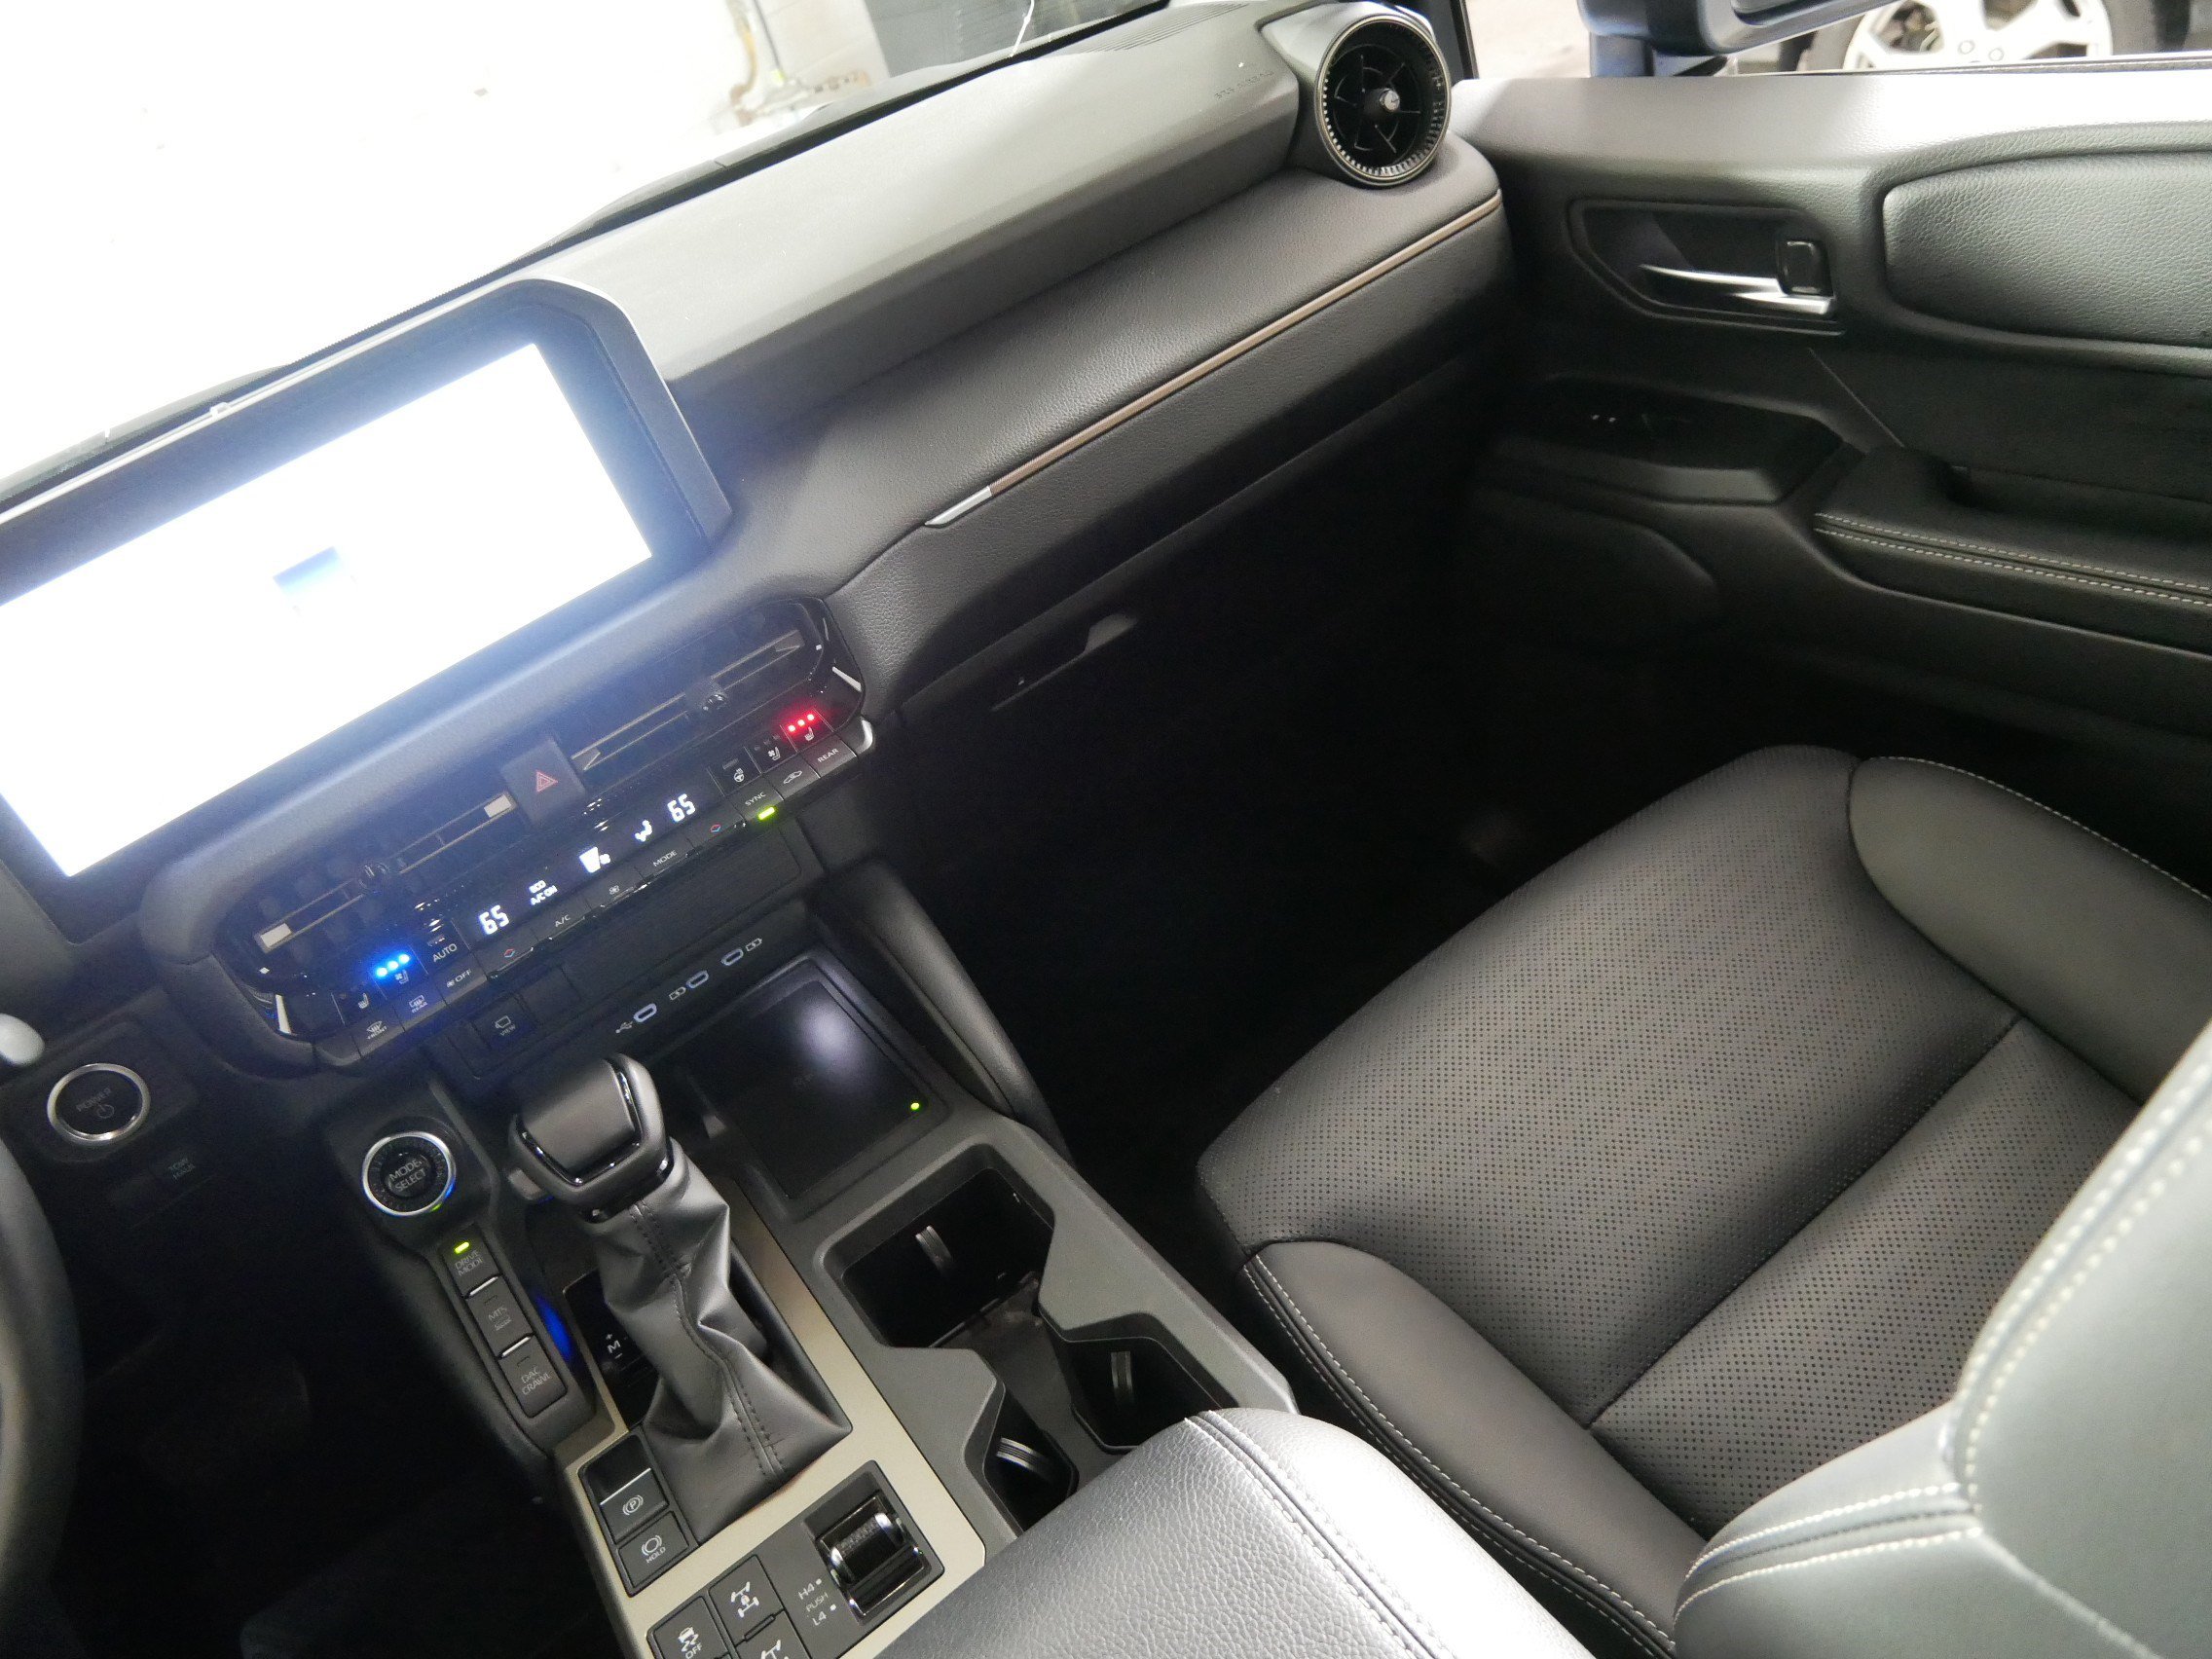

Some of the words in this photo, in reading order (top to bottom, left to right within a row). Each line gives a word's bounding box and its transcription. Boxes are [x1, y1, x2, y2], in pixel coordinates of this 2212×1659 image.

[818, 748, 838, 763] REAR
[667, 793, 696, 822] 65
[745, 792, 766, 806] SYNC
[652, 849, 677, 867] MODE
[478, 904, 509, 935] 65
[554, 914, 571, 928] A/C
[432, 943, 457, 963] AUTO
[455, 969, 472, 983] OFF
[389, 1159, 421, 1181] MODE
[394, 1168, 426, 1192] SELECT
[608, 1340, 621, 1354] M
[645, 1547, 666, 1564] HOLD
[798, 1583, 815, 1600] H4
[806, 1592, 829, 1612] PUSH
[812, 1611, 828, 1626] L4
[685, 1644, 702, 1659] OFF
